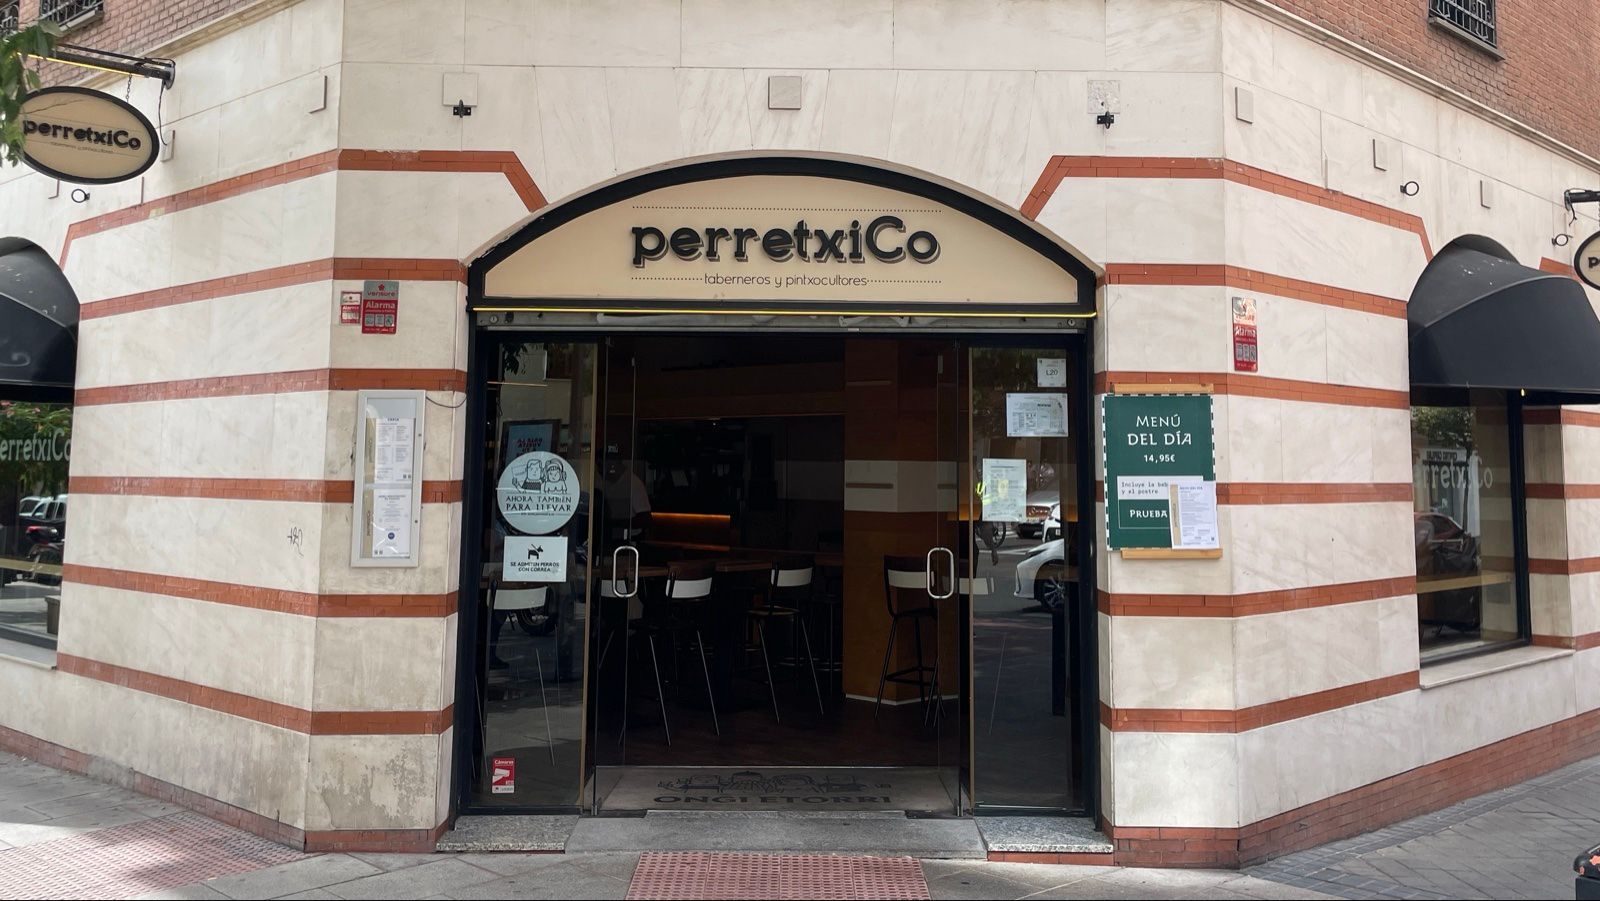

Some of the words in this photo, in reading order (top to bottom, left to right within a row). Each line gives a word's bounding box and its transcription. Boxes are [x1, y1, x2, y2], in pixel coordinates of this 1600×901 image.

[24, 120, 141, 150] perretxiCo
[631, 215, 942, 269] perretxiCo
[704, 273, 771, 286] taberneros
[774, 276, 782, 288] y
[785, 274, 867, 288] pintxocultores
[366, 301, 396, 309] Alarma
[1136, 414, 1181, 428] MENÚ
[1127, 433, 1158, 446] DEL
[1163, 430, 1192, 446] DÍA
[1143, 454, 1176, 464] 14,95€
[1121, 481, 1145, 490] Incluye
[1137, 488, 1159, 496] postre
[505, 495, 533, 503] AHORA
[506, 503, 531, 511] PARA
[1129, 509, 1168, 518] PRUEBA
